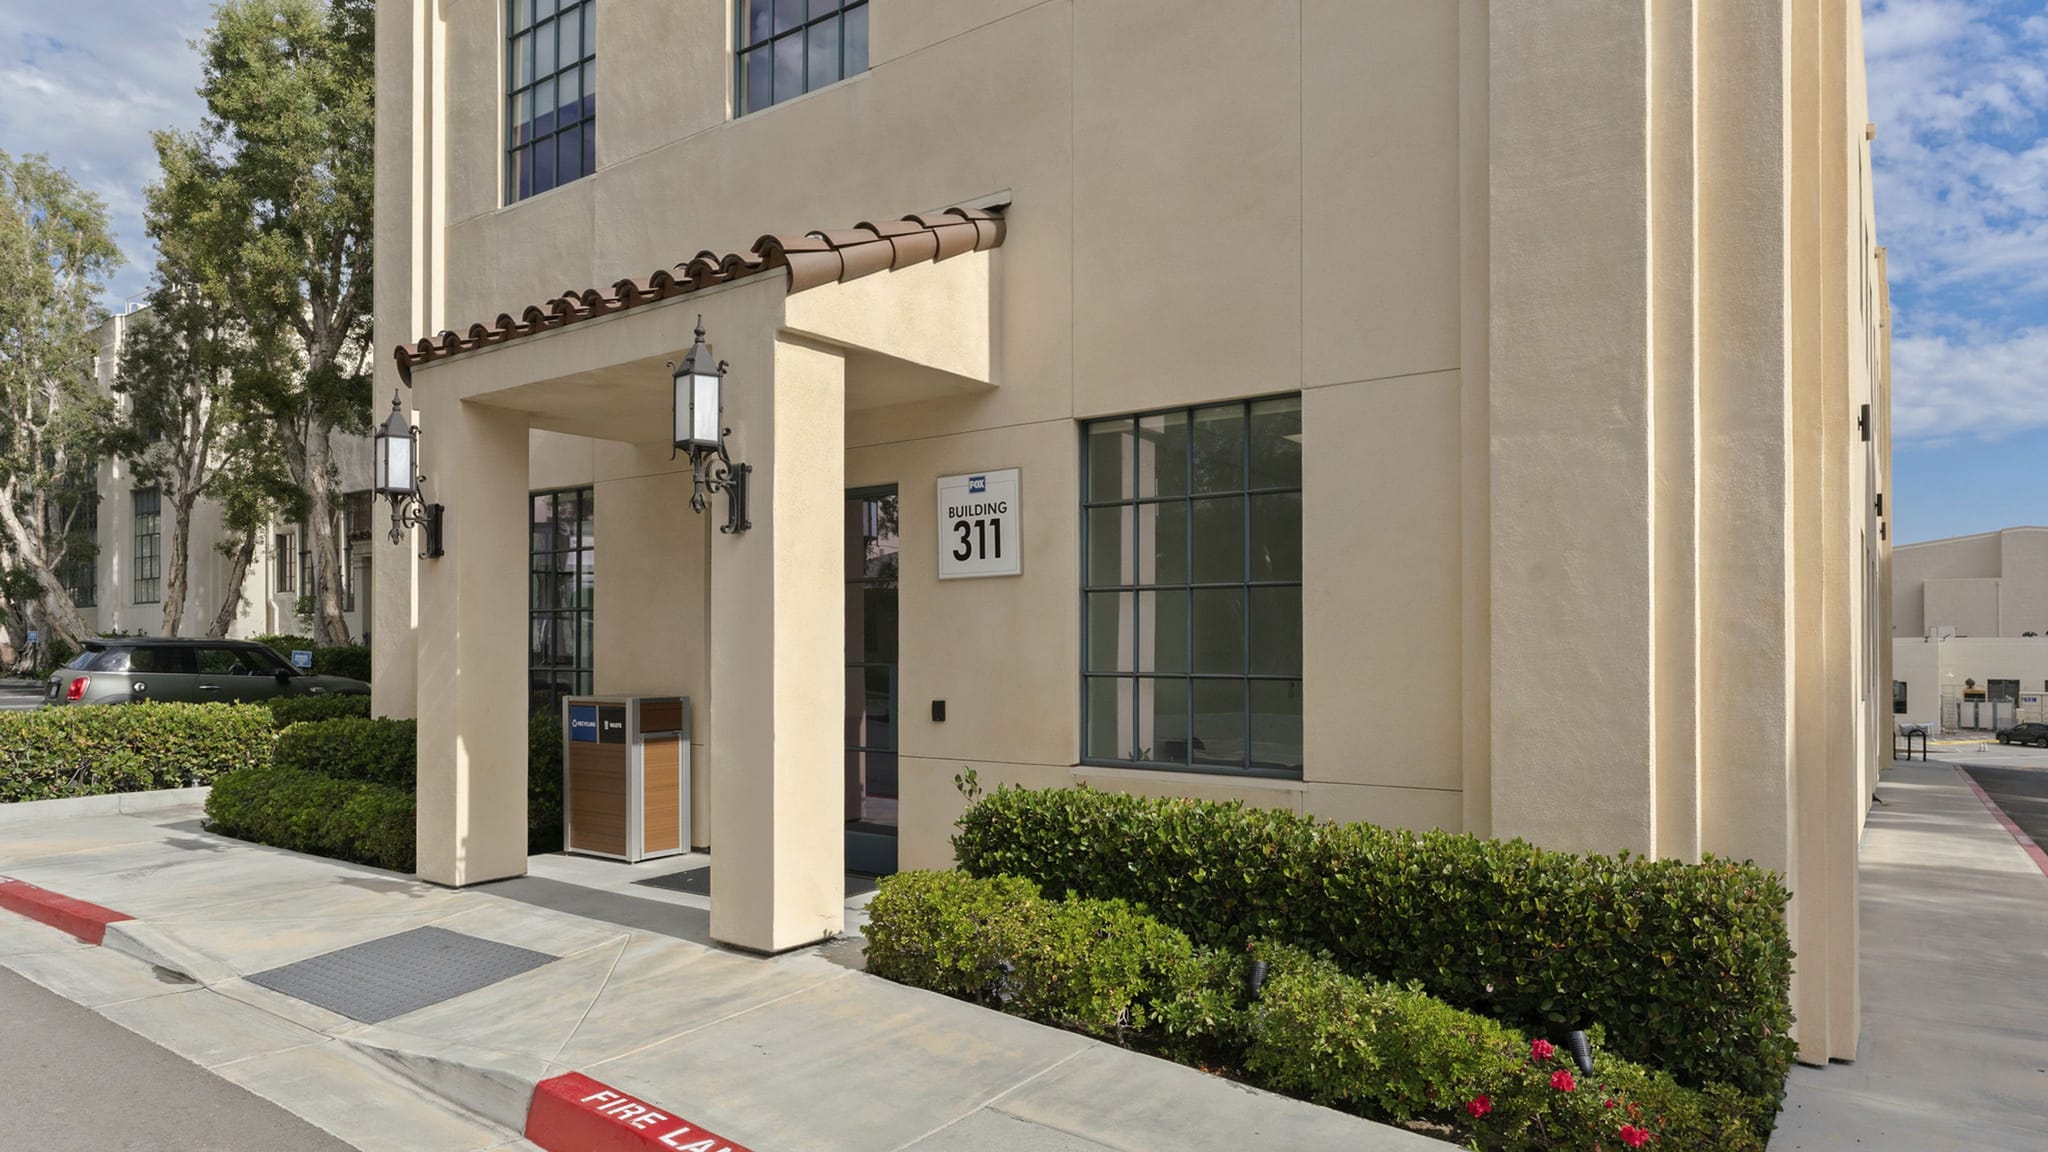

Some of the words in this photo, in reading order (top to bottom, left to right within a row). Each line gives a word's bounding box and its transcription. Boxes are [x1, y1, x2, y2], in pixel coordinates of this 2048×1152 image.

[969, 479, 985, 489] FOX
[948, 501, 1008, 518] BUILDING
[952, 518, 1001, 561] 311
[580, 1090, 667, 1130] FIRE
[658, 1127, 732, 1152] LA
